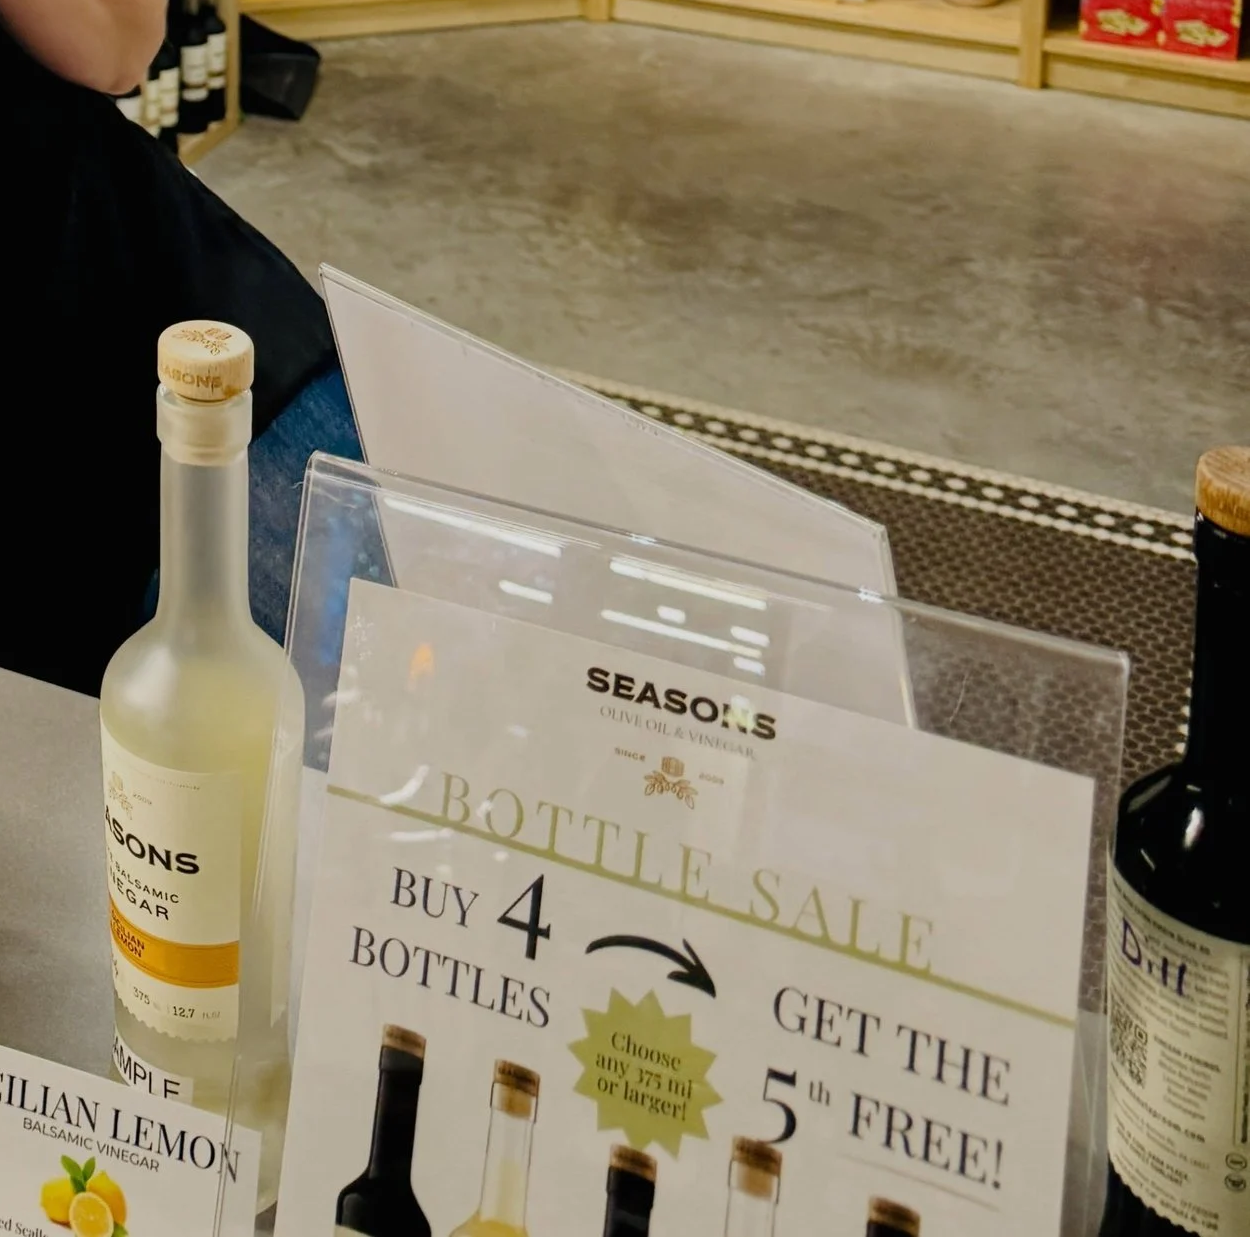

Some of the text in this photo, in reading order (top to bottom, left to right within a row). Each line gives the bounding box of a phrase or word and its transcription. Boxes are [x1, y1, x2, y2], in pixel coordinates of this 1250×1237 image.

[586, 666, 777, 741] SEASONS
[599, 704, 758, 762] OLIVE OIL & VINEGAR
[613, 746, 646, 763] SINCE
[105, 804, 200, 875] ASONS
[438, 770, 935, 978] BOTTLE SALE
[390, 866, 553, 961] BUY 4
[348, 925, 552, 1030] BOTTLES
[172, 1005, 196, 1020] 12.7
[113, 1036, 181, 1100] AMPLE
[595, 1050, 695, 1101] any 375 ml
[609, 1029, 683, 1073] Choose
[772, 985, 1013, 1108] GET THE
[595, 1073, 688, 1123] or larger!
[760, 1068, 1004, 1191] 5 th FREE!
[22, 1116, 160, 1174] BALSAMIC VINEGAR
[111, 1106, 242, 1184] LEMON
